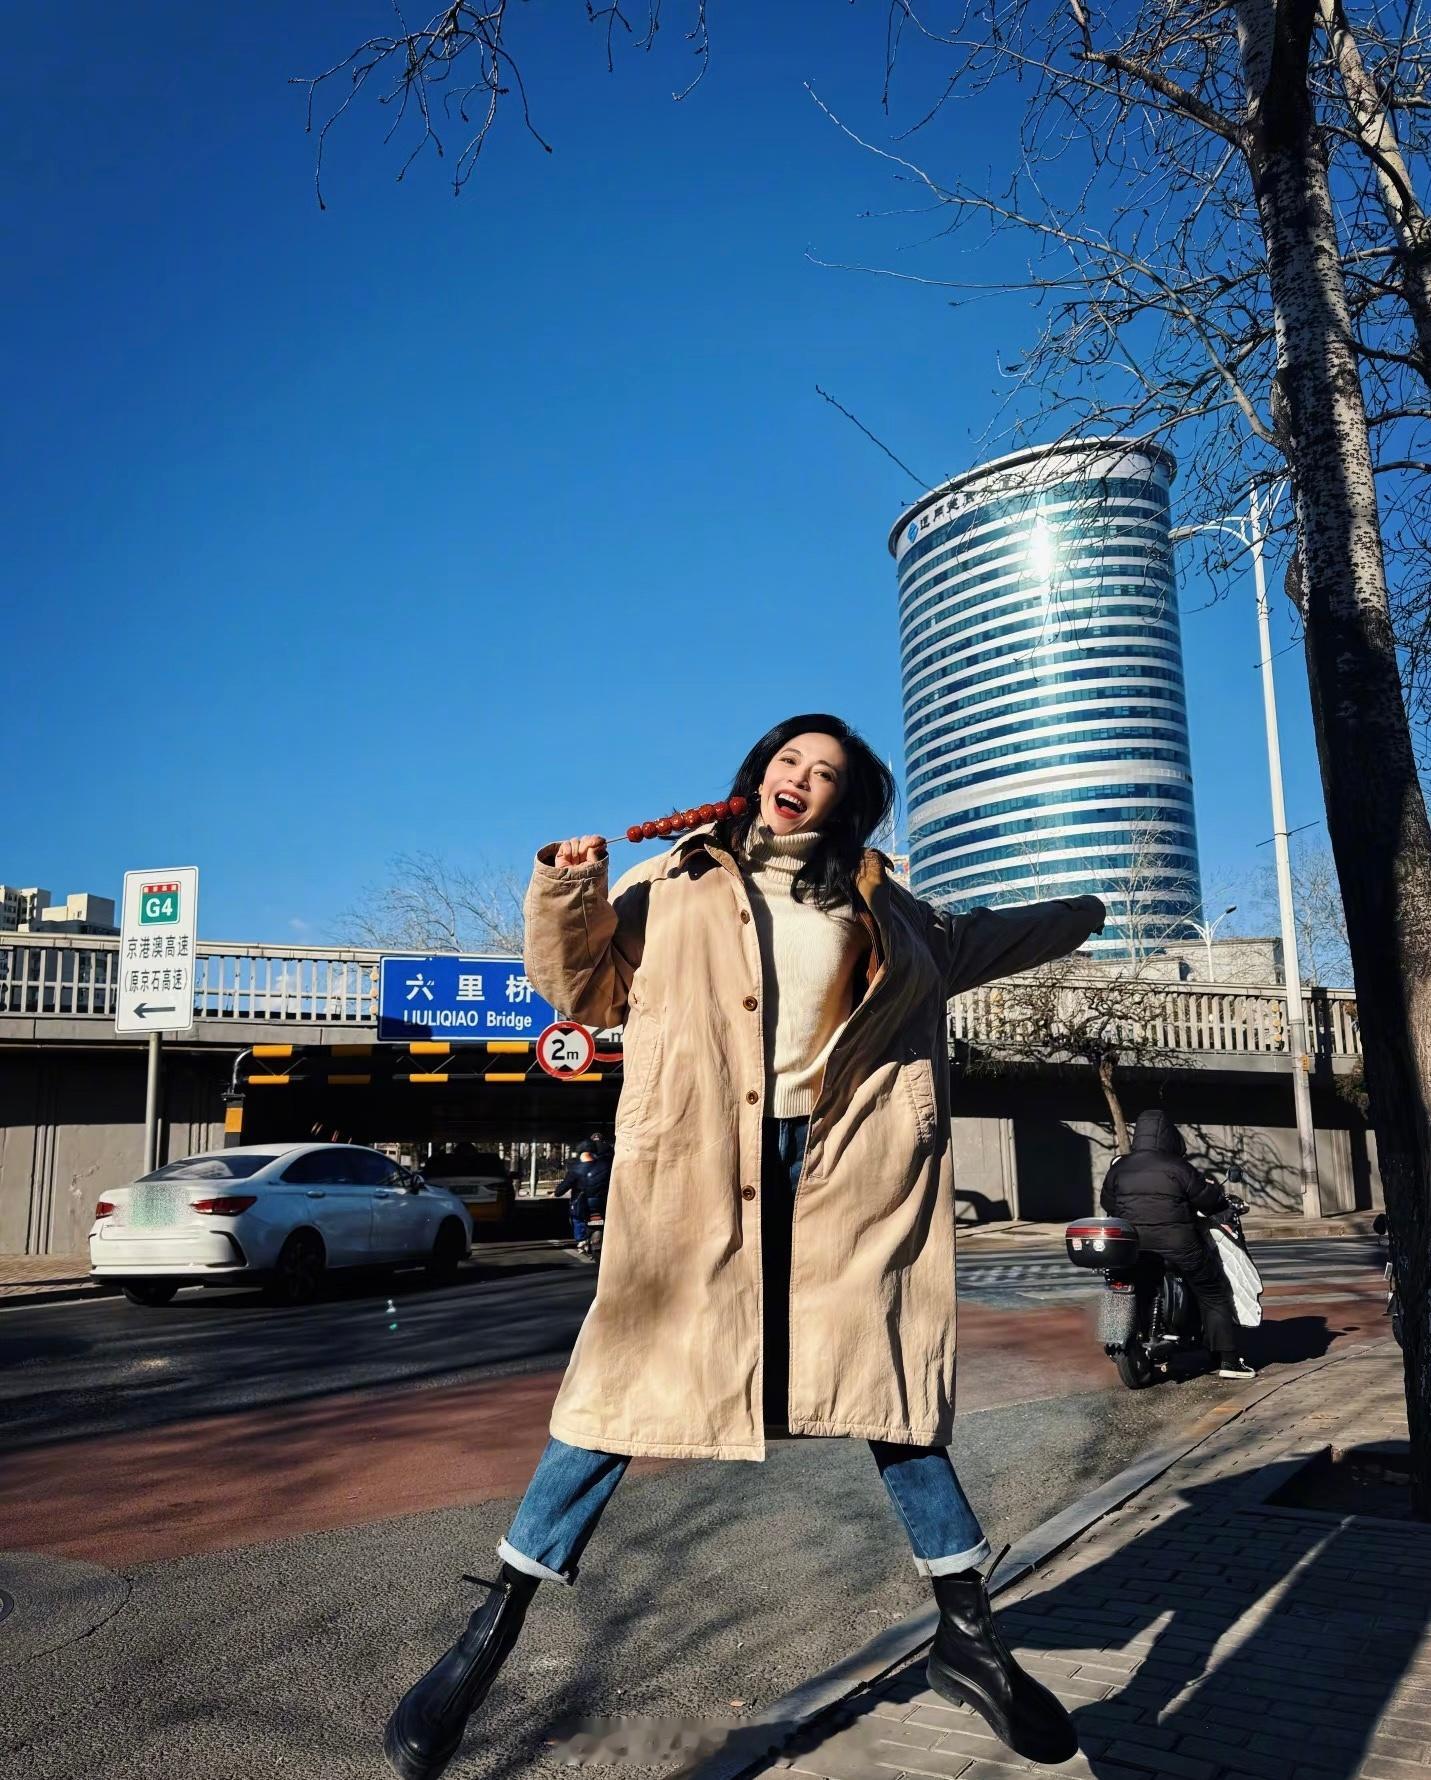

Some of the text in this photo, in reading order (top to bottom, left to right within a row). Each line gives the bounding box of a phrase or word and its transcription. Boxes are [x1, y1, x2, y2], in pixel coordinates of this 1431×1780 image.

[145, 897, 173, 918] G4
[126, 935, 189, 960] 京港澳高速
[124, 967, 188, 993] （原京石高速）
[405, 973, 535, 1003] 六里桥
[403, 1009, 533, 1031] LIULIQIAO Bridge
[551, 1038, 579, 1061] 2m
